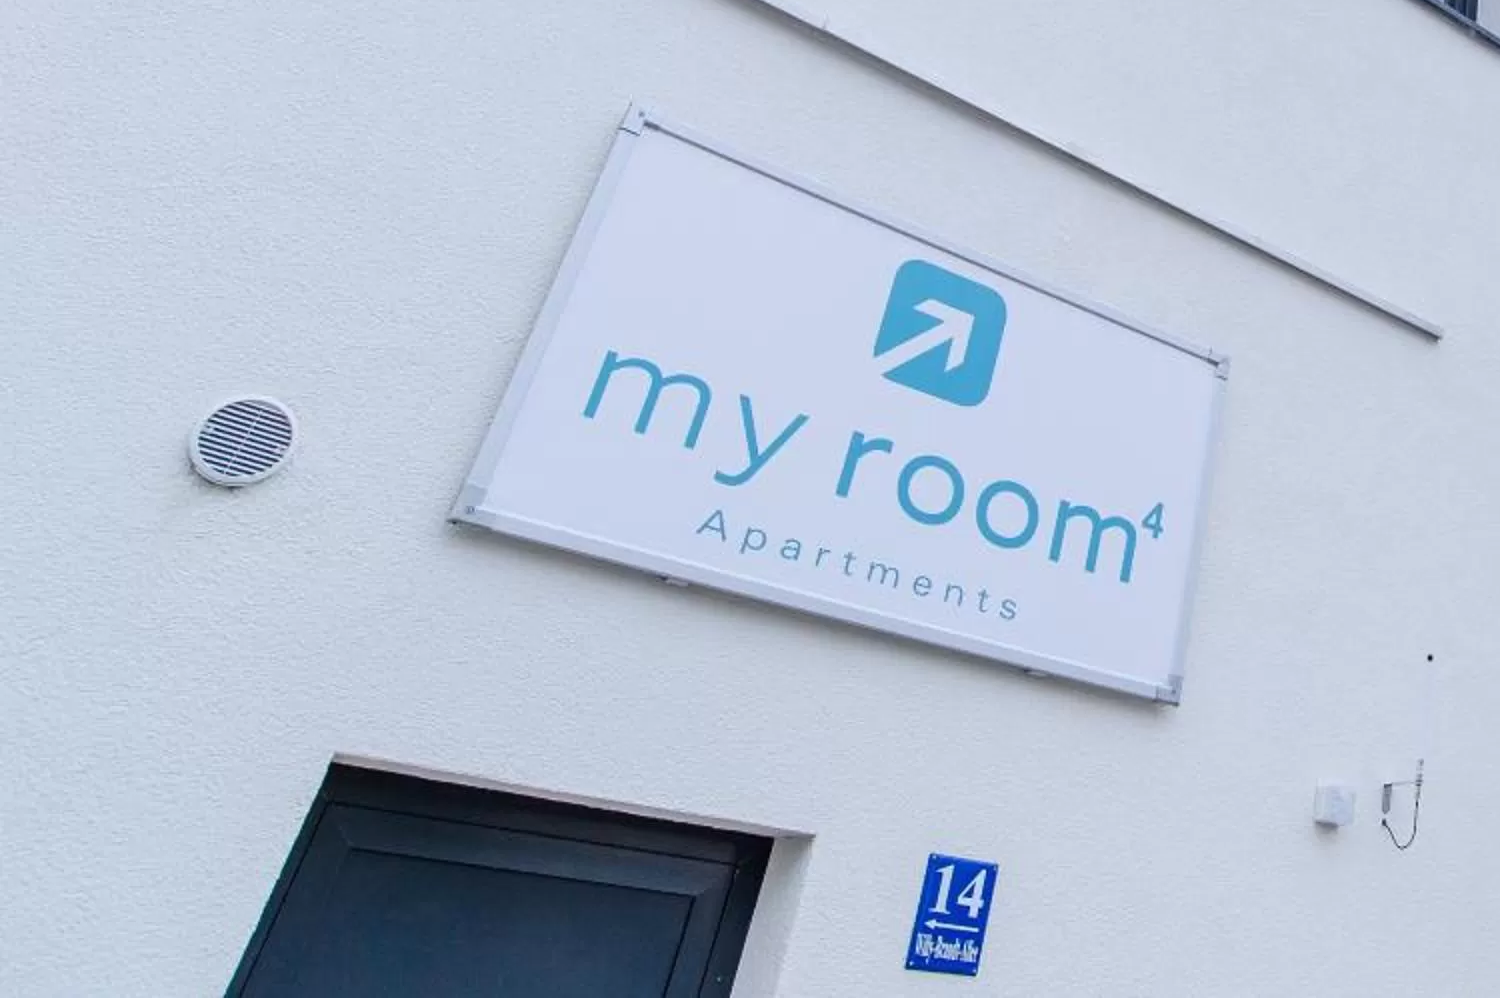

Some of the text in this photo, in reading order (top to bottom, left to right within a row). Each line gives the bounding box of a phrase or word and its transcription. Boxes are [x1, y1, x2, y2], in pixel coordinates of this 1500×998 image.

[582, 348, 809, 487] my
[695, 508, 1019, 621] Apartments
[927, 864, 987, 918] 14
